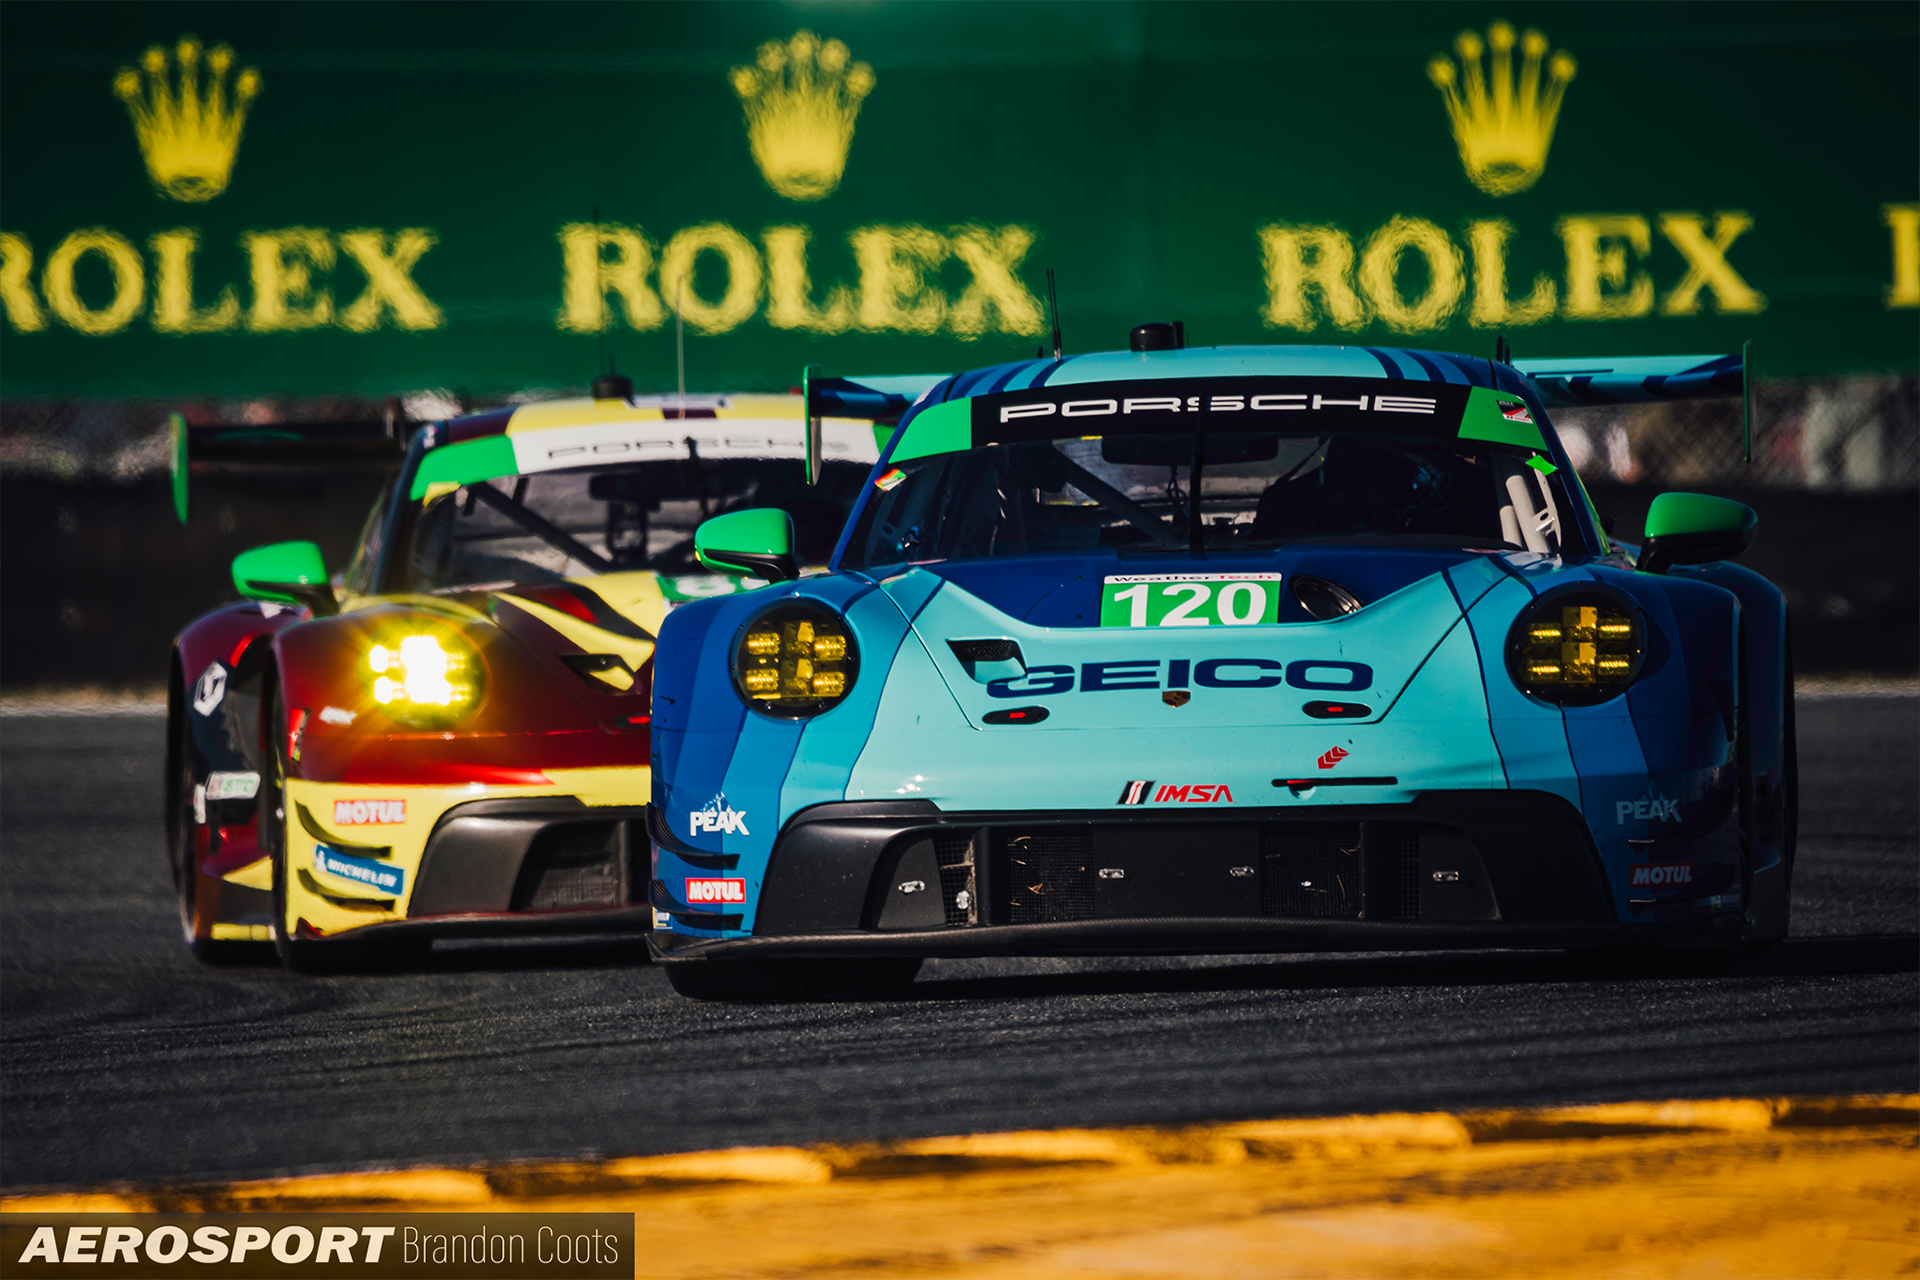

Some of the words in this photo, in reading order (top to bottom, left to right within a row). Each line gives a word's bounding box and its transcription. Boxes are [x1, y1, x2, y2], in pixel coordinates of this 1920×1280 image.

[556, 220, 1046, 341] ROLEX
[1257, 212, 1767, 334] ROLEX
[1000, 394, 1436, 423] PORSCHE
[1114, 582, 1267, 627] 120
[987, 658, 1373, 698] GEICO
[1154, 785, 1233, 802] IMSA
[334, 801, 406, 824] MOTUL
[690, 810, 750, 836] PEAK
[1616, 799, 1683, 825] PEAK
[327, 858, 398, 888] MICHELIN
[1632, 865, 1692, 884] MOTUL
[688, 881, 743, 900] MOTUL
